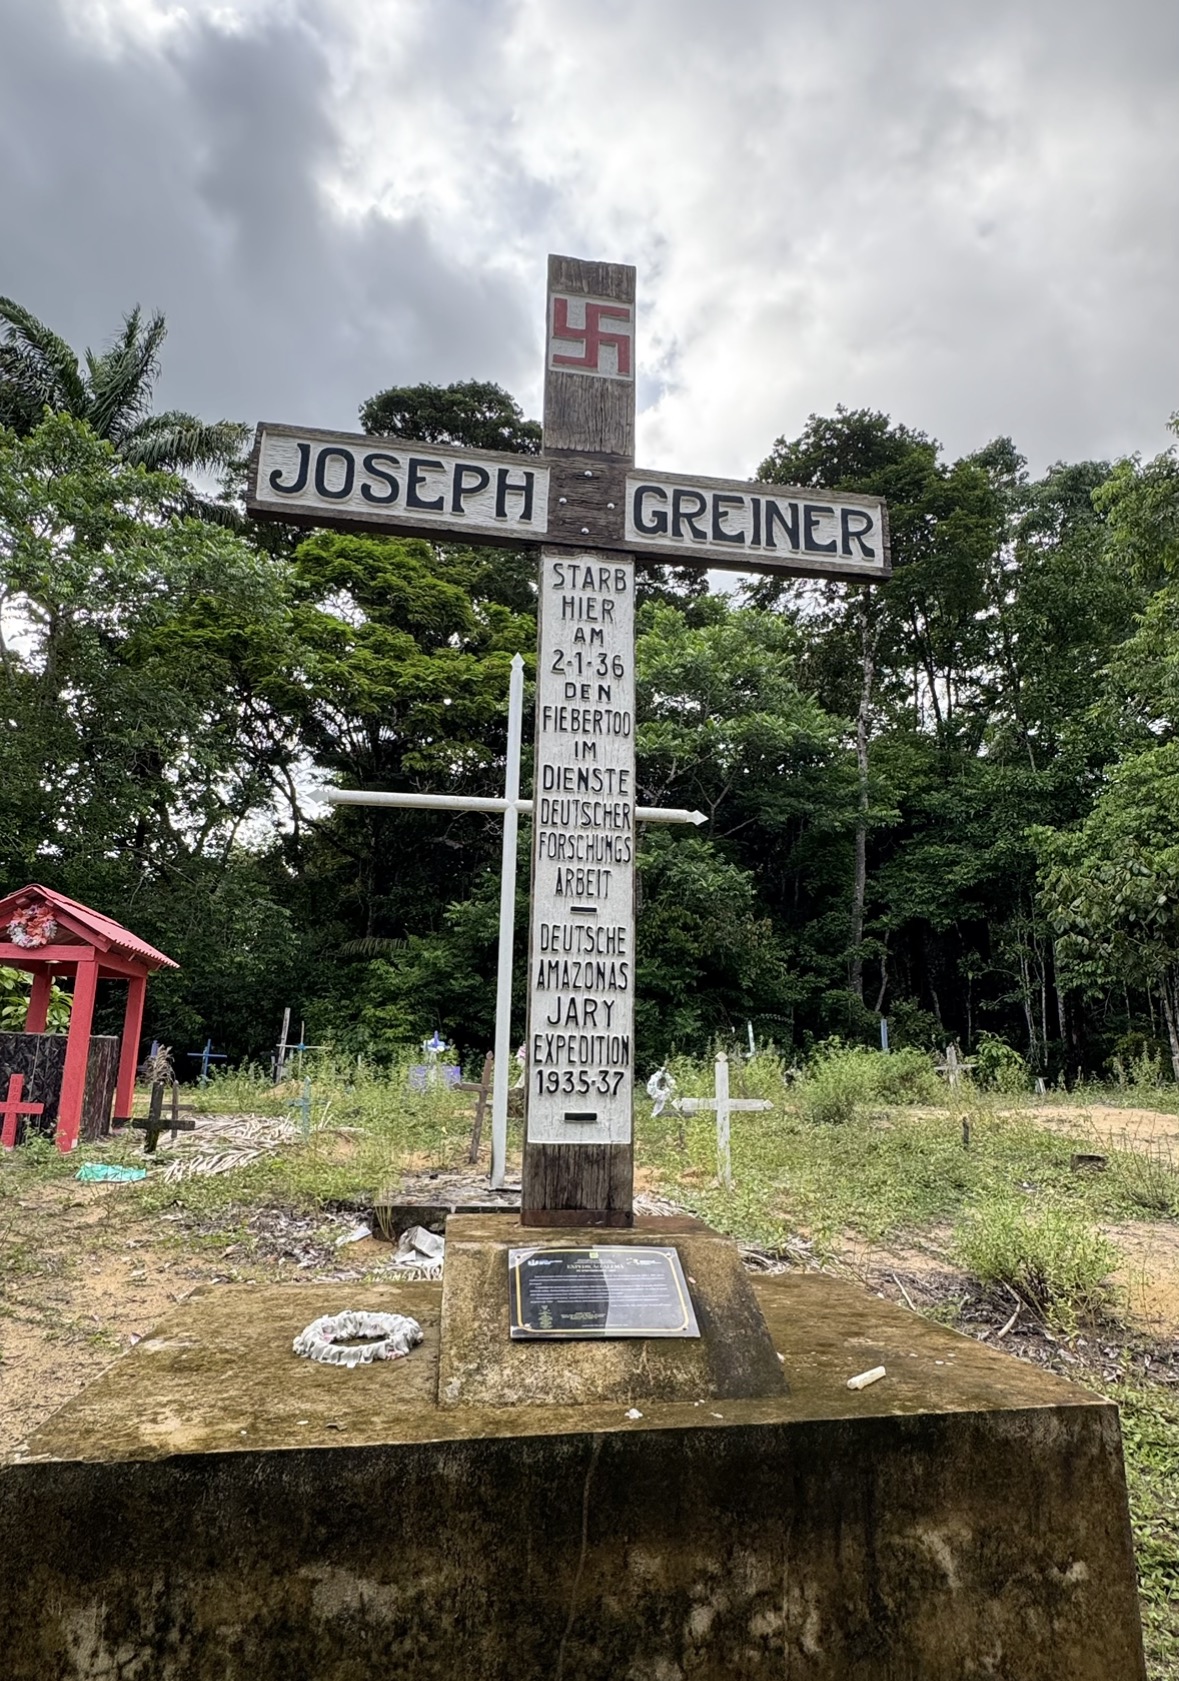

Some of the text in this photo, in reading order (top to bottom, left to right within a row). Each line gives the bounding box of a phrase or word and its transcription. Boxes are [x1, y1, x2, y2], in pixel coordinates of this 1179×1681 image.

[269, 443, 876, 558] JOSEPH GREINER
[552, 562, 627, 592] STARB
[561, 595, 615, 622] HIER
[573, 627, 604, 644] AM
[564, 682, 612, 701] DEN
[574, 741, 597, 759] IM
[542, 765, 631, 795] DIENSTE
[540, 798, 631, 830] DEUTSCHER
[538, 831, 631, 863] FORSCHUNGS
[555, 866, 613, 899] ARBEIT
[540, 923, 627, 954] DEUTSCHE
[536, 959, 629, 990] AMAZONAS
[546, 996, 615, 1027] JARY
[533, 1033, 630, 1066] EXPEDITION
